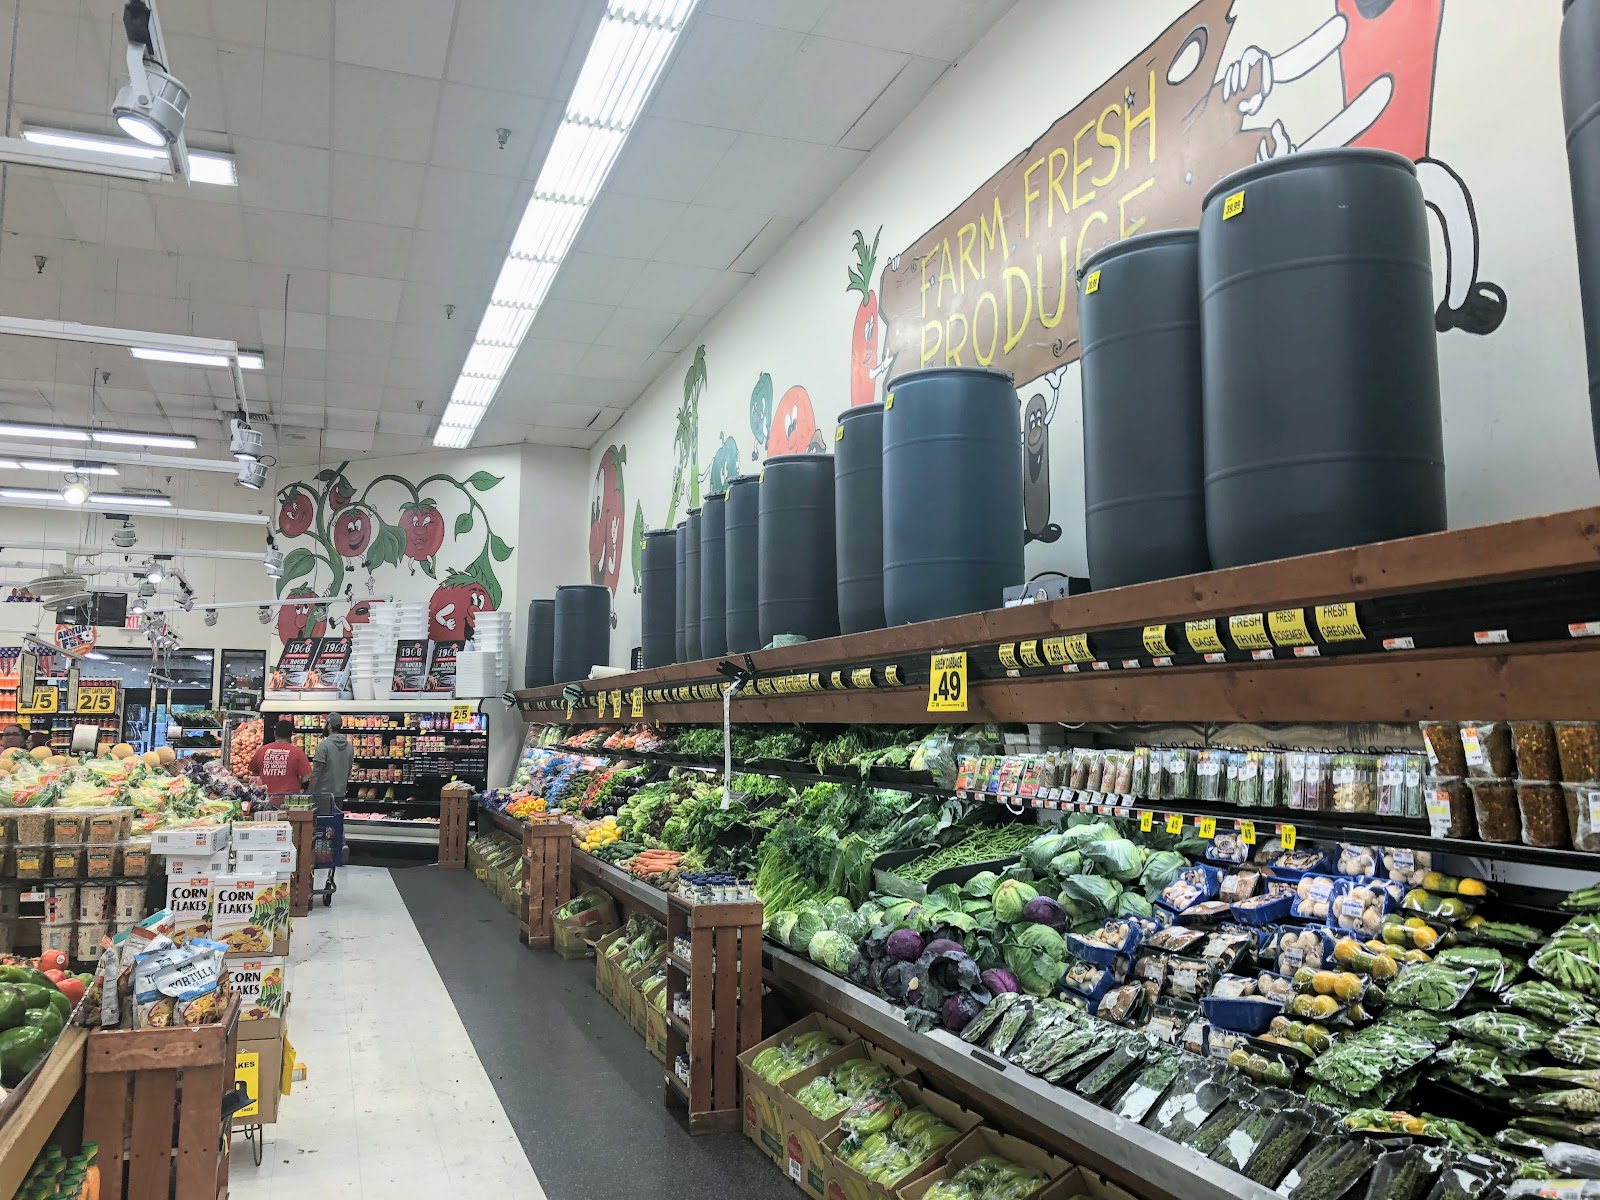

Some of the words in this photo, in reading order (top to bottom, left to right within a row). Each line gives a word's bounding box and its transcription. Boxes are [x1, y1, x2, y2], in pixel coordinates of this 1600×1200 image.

[920, 196, 1009, 318] FARM
[1024, 70, 1156, 239] FRESH
[920, 178, 1155, 368] PRODUCE
[1276, 611, 1296, 623] FRESH
[1324, 604, 1348, 618] FRESH
[126, 616, 140, 628] XIT
[1186, 620, 1215, 631] FRESH
[1232, 616, 1261, 628] FRESH
[1273, 629, 1307, 640] ROSEMERY
[1321, 624, 1360, 637] OREGANO
[1193, 636, 1218, 647] SAGE
[1234, 633, 1268, 644] THYME
[933, 671, 961, 701] .49
[80, 695, 110, 710] 2/5
[453, 710, 468, 720] 2/5
[172, 887, 208, 899] CORN
[218, 890, 255, 901] CORN
[171, 900, 207, 912] FLAKES
[217, 903, 253, 914] FLAKES
[168, 966, 216, 989] TORTILLA
[228, 971, 261, 982] CORN
[230, 984, 260, 996] LAKES
